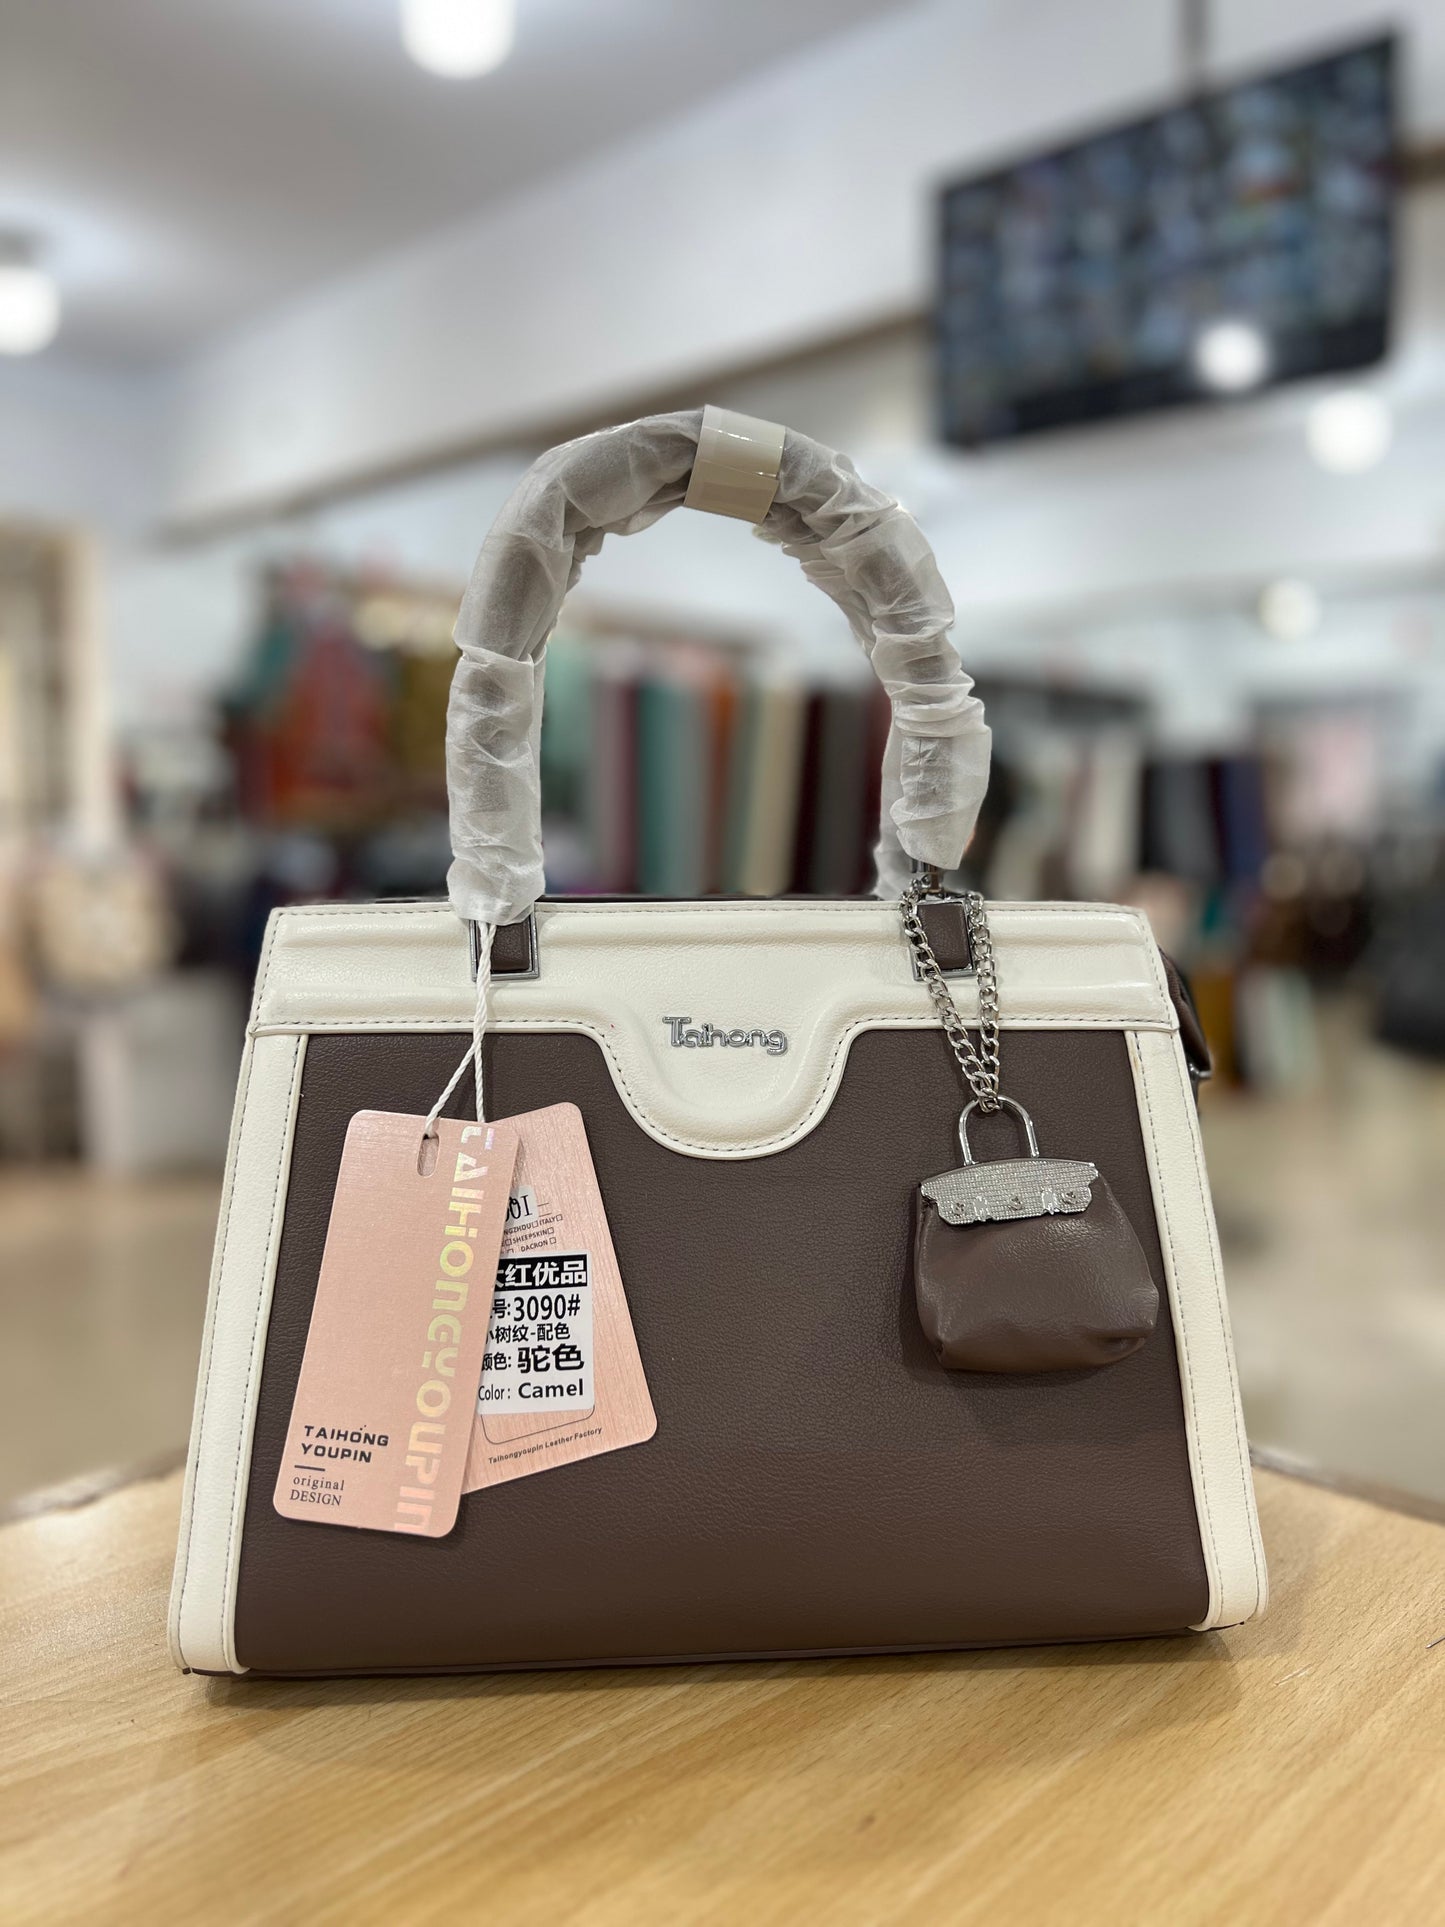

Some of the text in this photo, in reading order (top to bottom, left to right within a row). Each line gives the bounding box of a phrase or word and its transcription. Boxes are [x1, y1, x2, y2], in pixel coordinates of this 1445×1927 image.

[662, 1016, 788, 1056] Taihong
[539, 1216, 557, 1226] ITALY
[512, 1229, 548, 1244] SHEEPSKIN
[520, 1240, 549, 1253] DACRON
[517, 1343, 585, 1374] 驼色
[518, 1378, 584, 1399] Camel
[304, 1425, 389, 1447] TAIHONG
[488, 1427, 602, 1464] Taihongyoupin Leather Factory
[301, 1443, 372, 1463] YOUPIN
[293, 1475, 345, 1491] original
[289, 1489, 342, 1506] DESIGN
